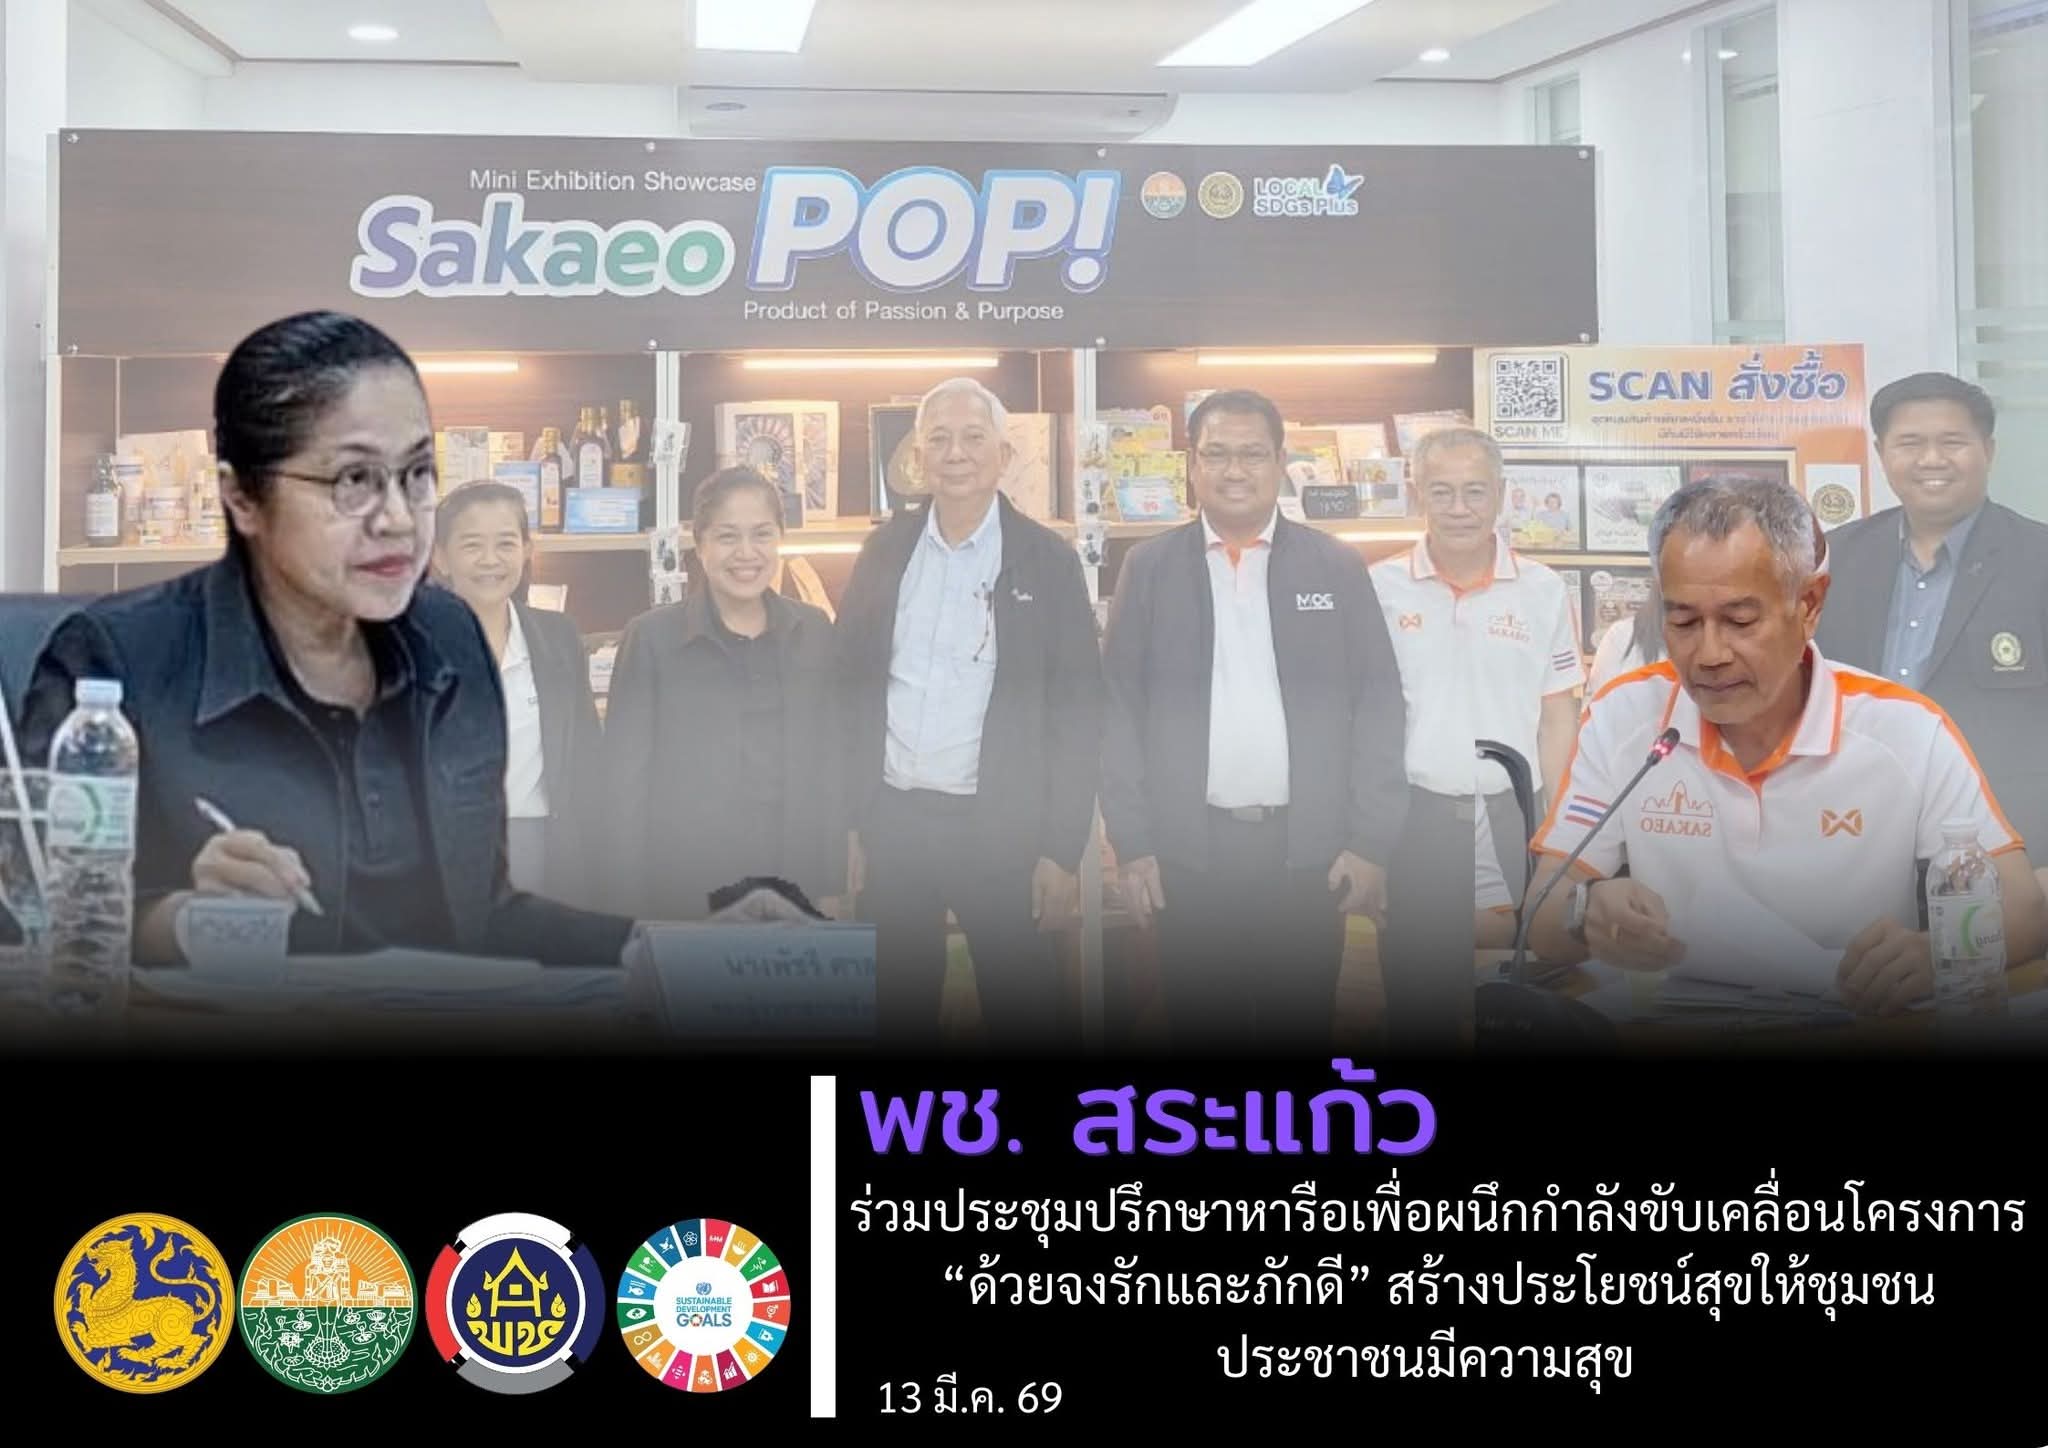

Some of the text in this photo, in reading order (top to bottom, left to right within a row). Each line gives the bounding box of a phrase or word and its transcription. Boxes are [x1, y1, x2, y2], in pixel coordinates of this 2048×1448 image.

[470, 169, 757, 192] Mini Exhibition Showcase
[1255, 178, 1325, 197] LOCAL
[1255, 199, 1310, 215] SDGs
[354, 165, 1122, 294] Sakaeo POP!
[744, 300, 1065, 324] Product of Passion & Purpose
[1589, 351, 1847, 401] SCAN สั่งซื้อ
